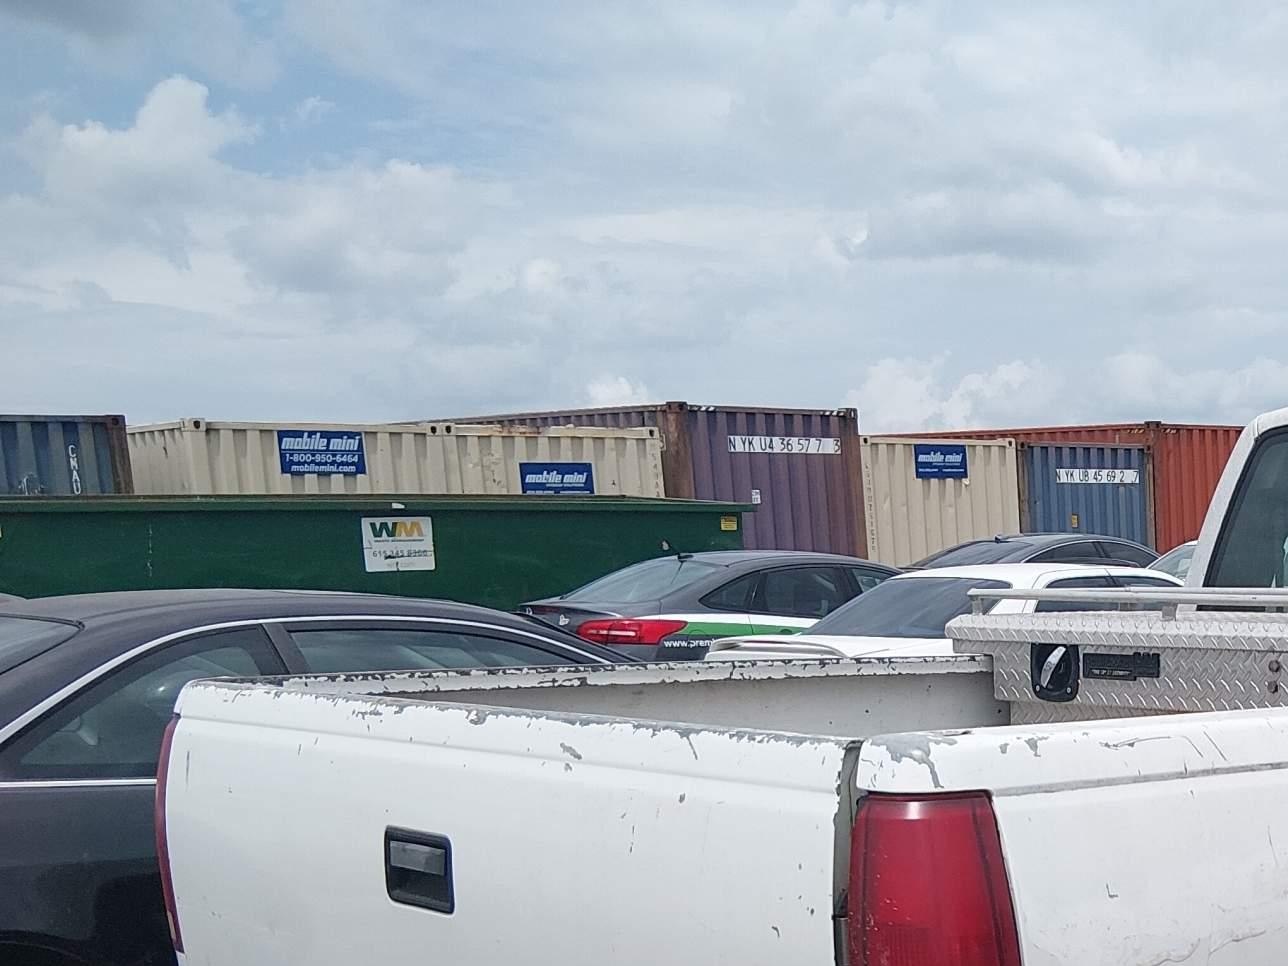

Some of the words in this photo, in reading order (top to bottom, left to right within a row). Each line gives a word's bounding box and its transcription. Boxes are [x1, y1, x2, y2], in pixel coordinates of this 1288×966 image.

[281, 432, 328, 450] mobile
[329, 436, 361, 450] mini
[285, 453, 359, 463] 1-800-950-6464
[68, 444, 81, 495] CMAU
[525, 470, 563, 483] mobile
[563, 472, 588, 483] mini
[369, 521, 424, 538] WM
[663, 638, 714, 648] www.prem
